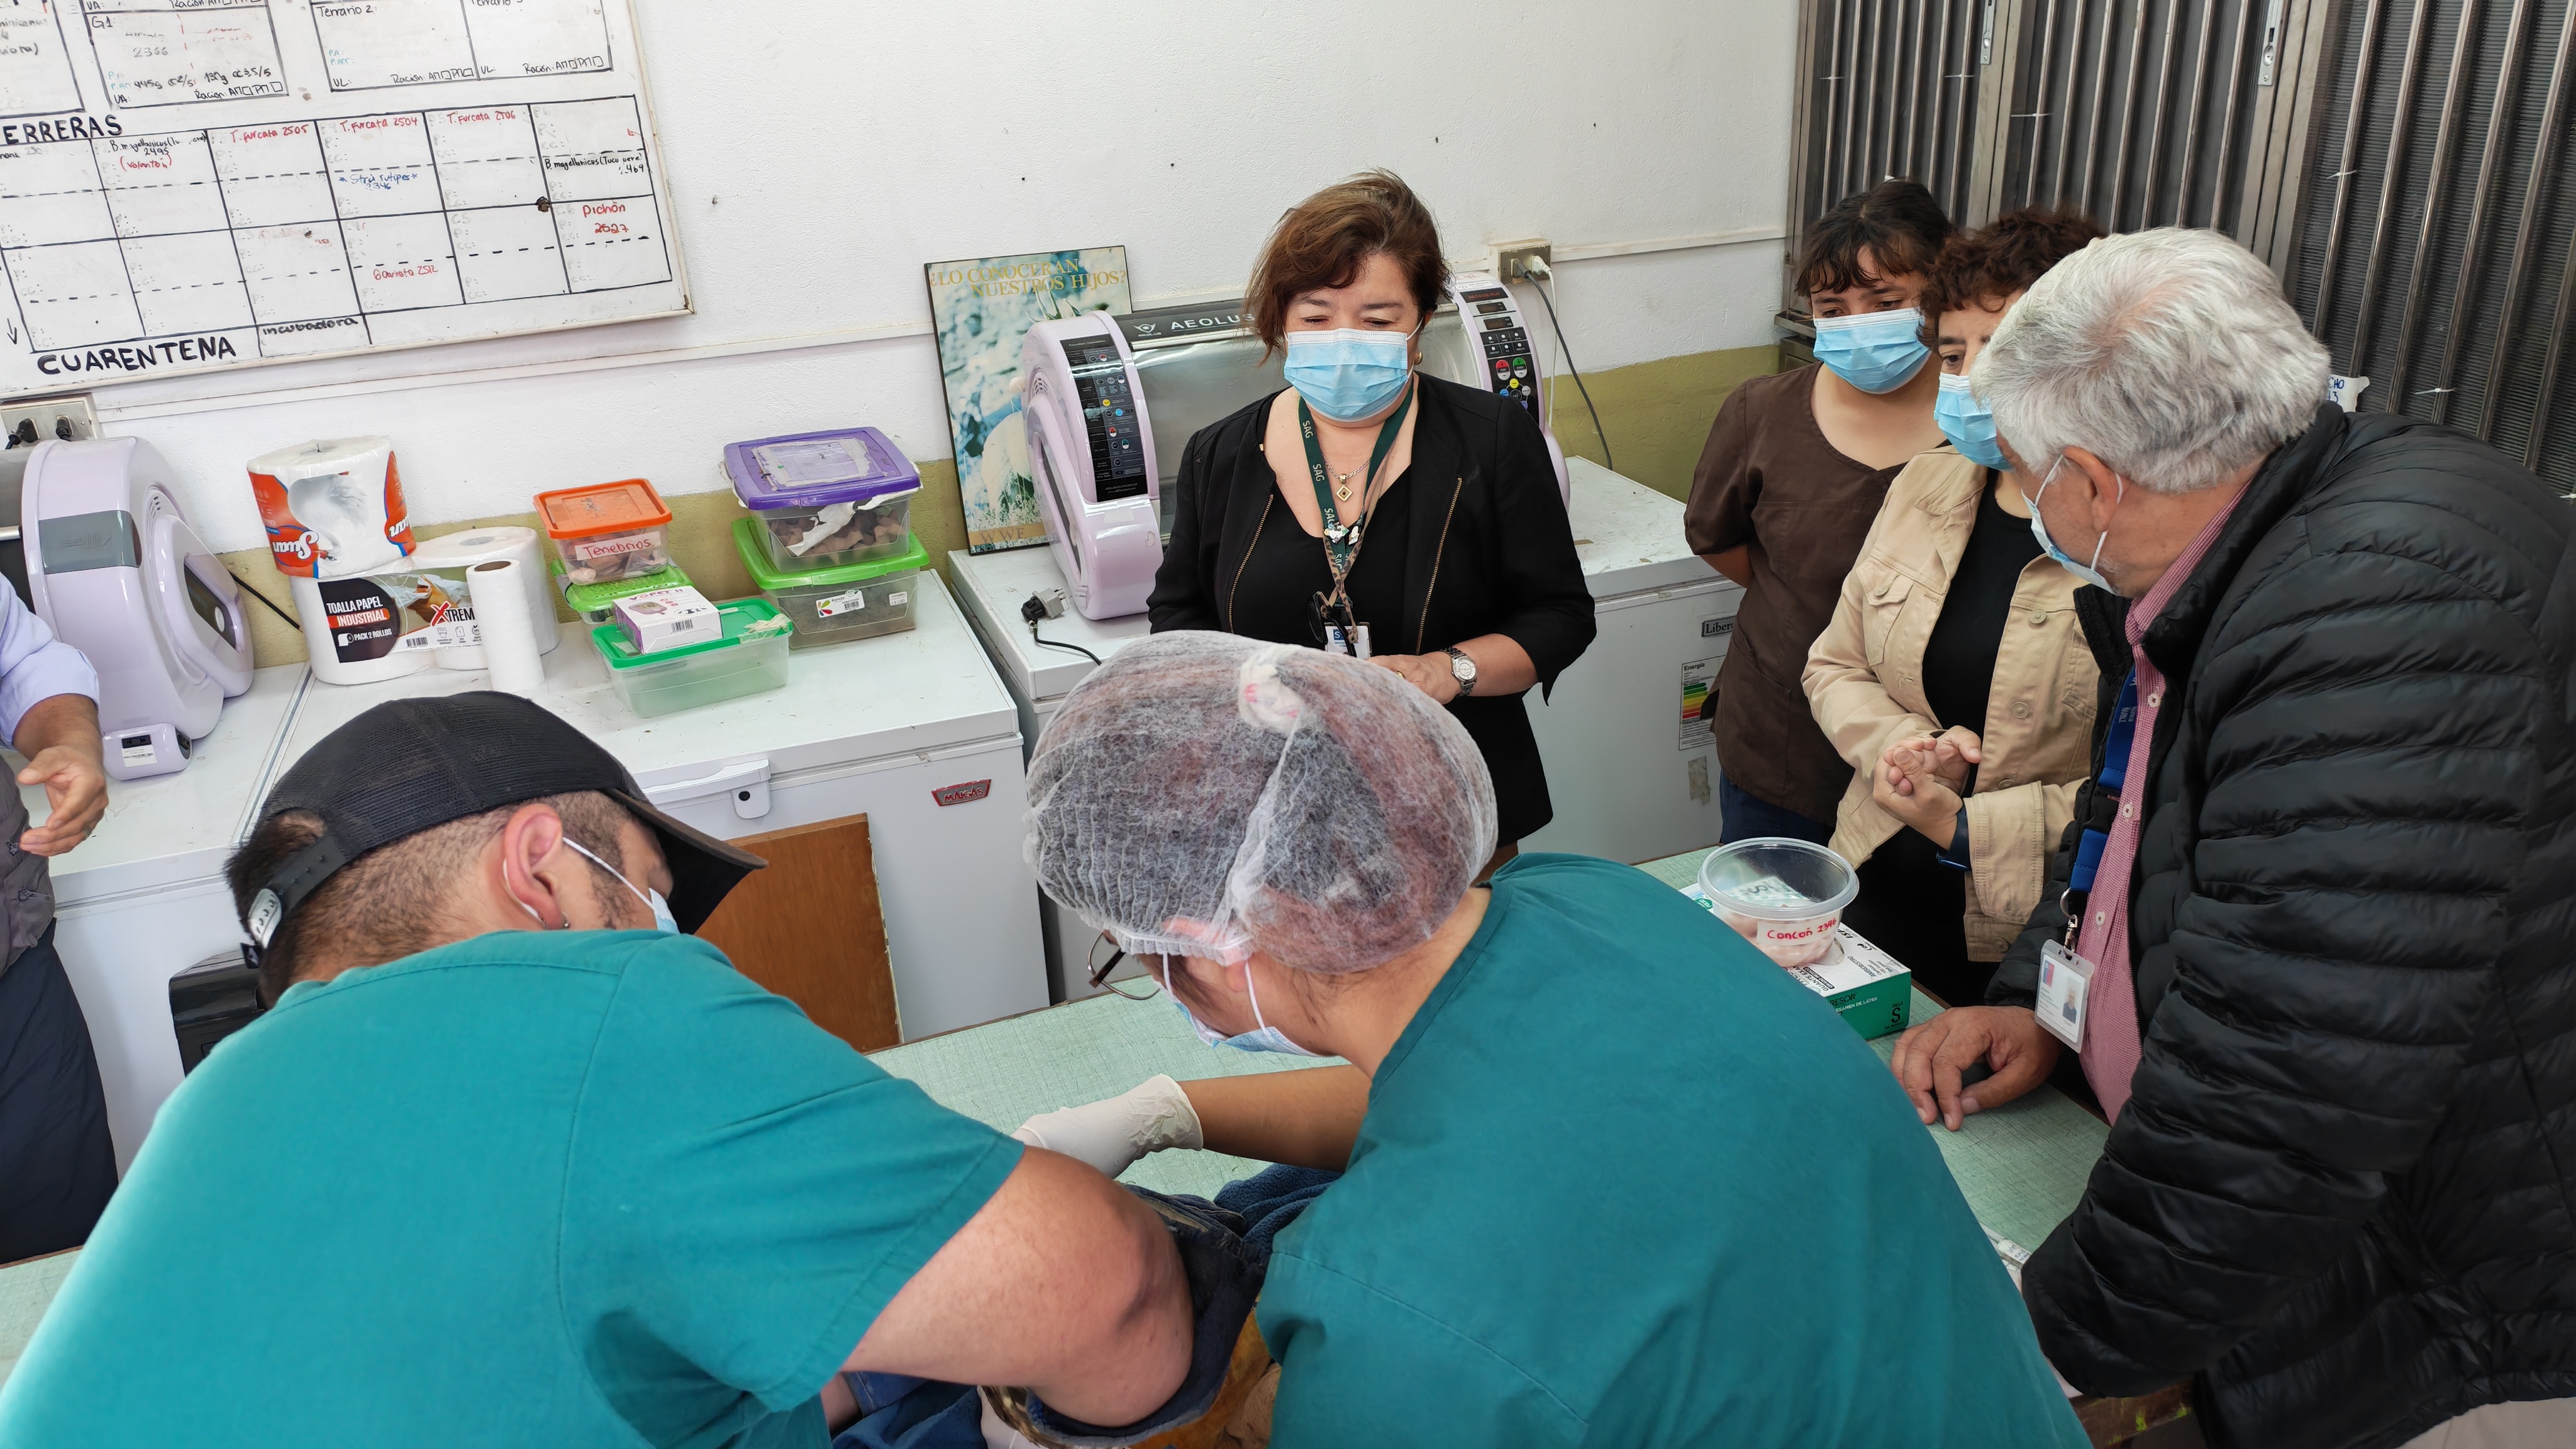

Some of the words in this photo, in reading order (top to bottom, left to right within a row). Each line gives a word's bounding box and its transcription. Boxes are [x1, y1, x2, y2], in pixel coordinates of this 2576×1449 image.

[316, 6, 362, 18] Terrario
[282, 125, 309, 136] 2505
[393, 117, 418, 126] 2504
[971, 276, 1065, 299] NUESTROS
[1071, 270, 1127, 291] HIJOS?
[1170, 313, 1257, 331] AEOLUS
[36, 336, 236, 375] CUARENTENA
[1302, 420, 1313, 439] SAG
[1313, 463, 1325, 482] SAG
[272, 530, 319, 560] Swan
[979, 528, 1026, 545] WWF
[583, 538, 652, 558] Tenebrios
[326, 600, 356, 614] TOALLA
[355, 596, 383, 610] PAPEL
[430, 600, 475, 627] XTREM
[336, 609, 387, 626] INDUSTRIAL
[353, 632, 368, 641] PACK
[372, 628, 392, 638] ROLLOS
[1829, 992, 1857, 1006] RESOR
[1891, 1008, 1901, 1023] S
